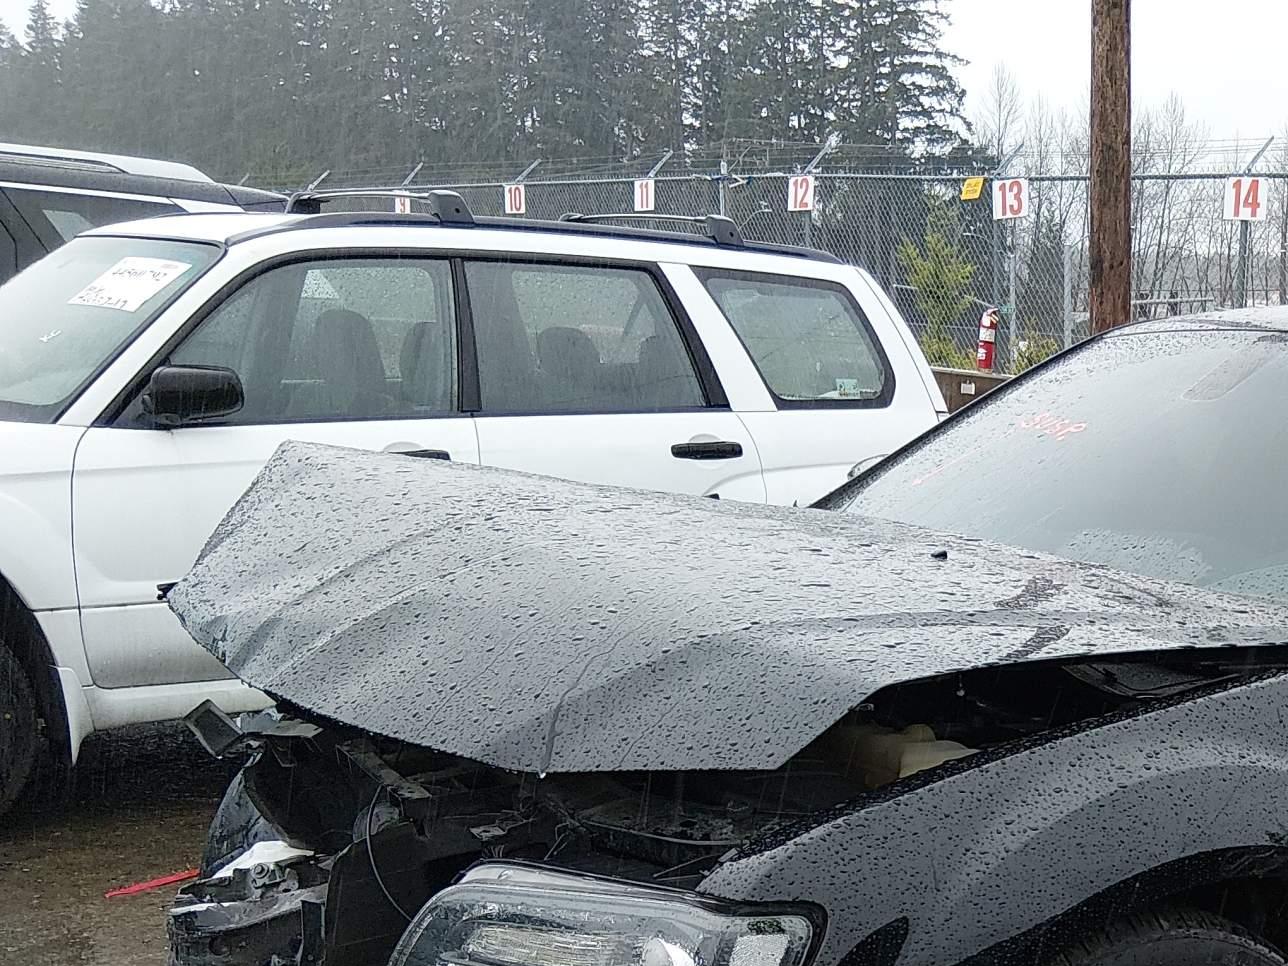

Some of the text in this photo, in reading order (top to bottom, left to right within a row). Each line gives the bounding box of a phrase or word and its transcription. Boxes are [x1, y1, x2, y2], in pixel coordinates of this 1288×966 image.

[508, 186, 522, 212] 10
[639, 181, 649, 209] 11
[793, 177, 809, 208] 12
[998, 180, 1023, 217] 13
[1232, 178, 1260, 218] 14
